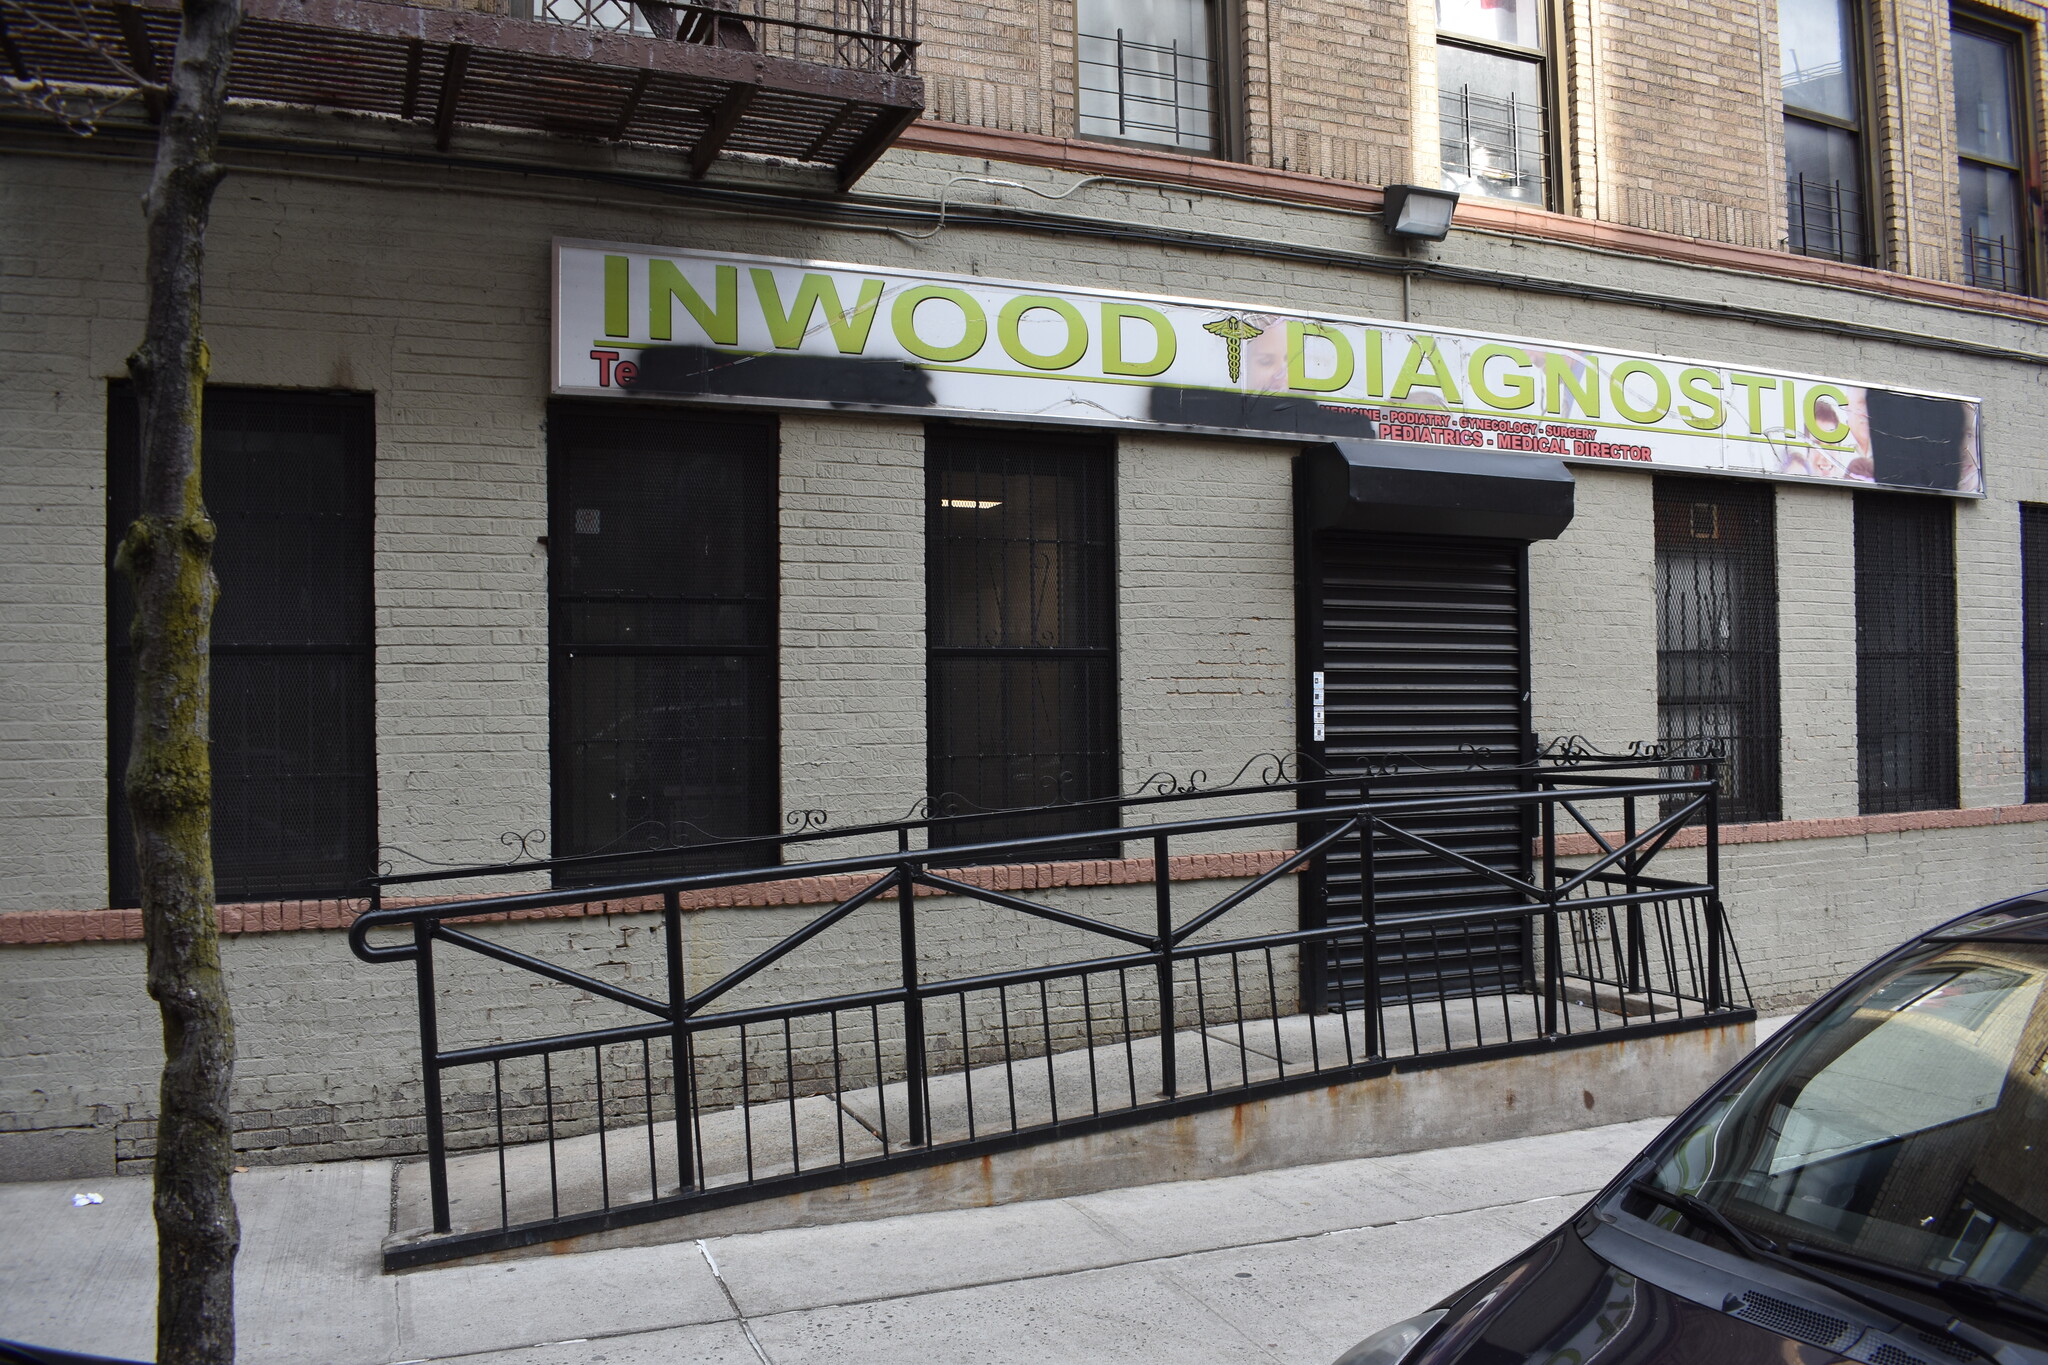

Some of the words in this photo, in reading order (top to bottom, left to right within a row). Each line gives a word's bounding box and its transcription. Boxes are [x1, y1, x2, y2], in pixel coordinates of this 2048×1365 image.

[604, 254, 1178, 377] INWOOD
[1286, 321, 1851, 443] DIAGNOSTIC
[1319, 404, 1381, 422] EDICINE
[1390, 410, 1451, 427] PODIATRY
[1459, 417, 1537, 434] GYNECOLOGY
[1545, 425, 1598, 440] SURGERY
[1379, 424, 1484, 447] PEDIATRICS
[1497, 433, 1571, 456] MEDICAL
[1573, 440, 1653, 462] DIRECTOR
